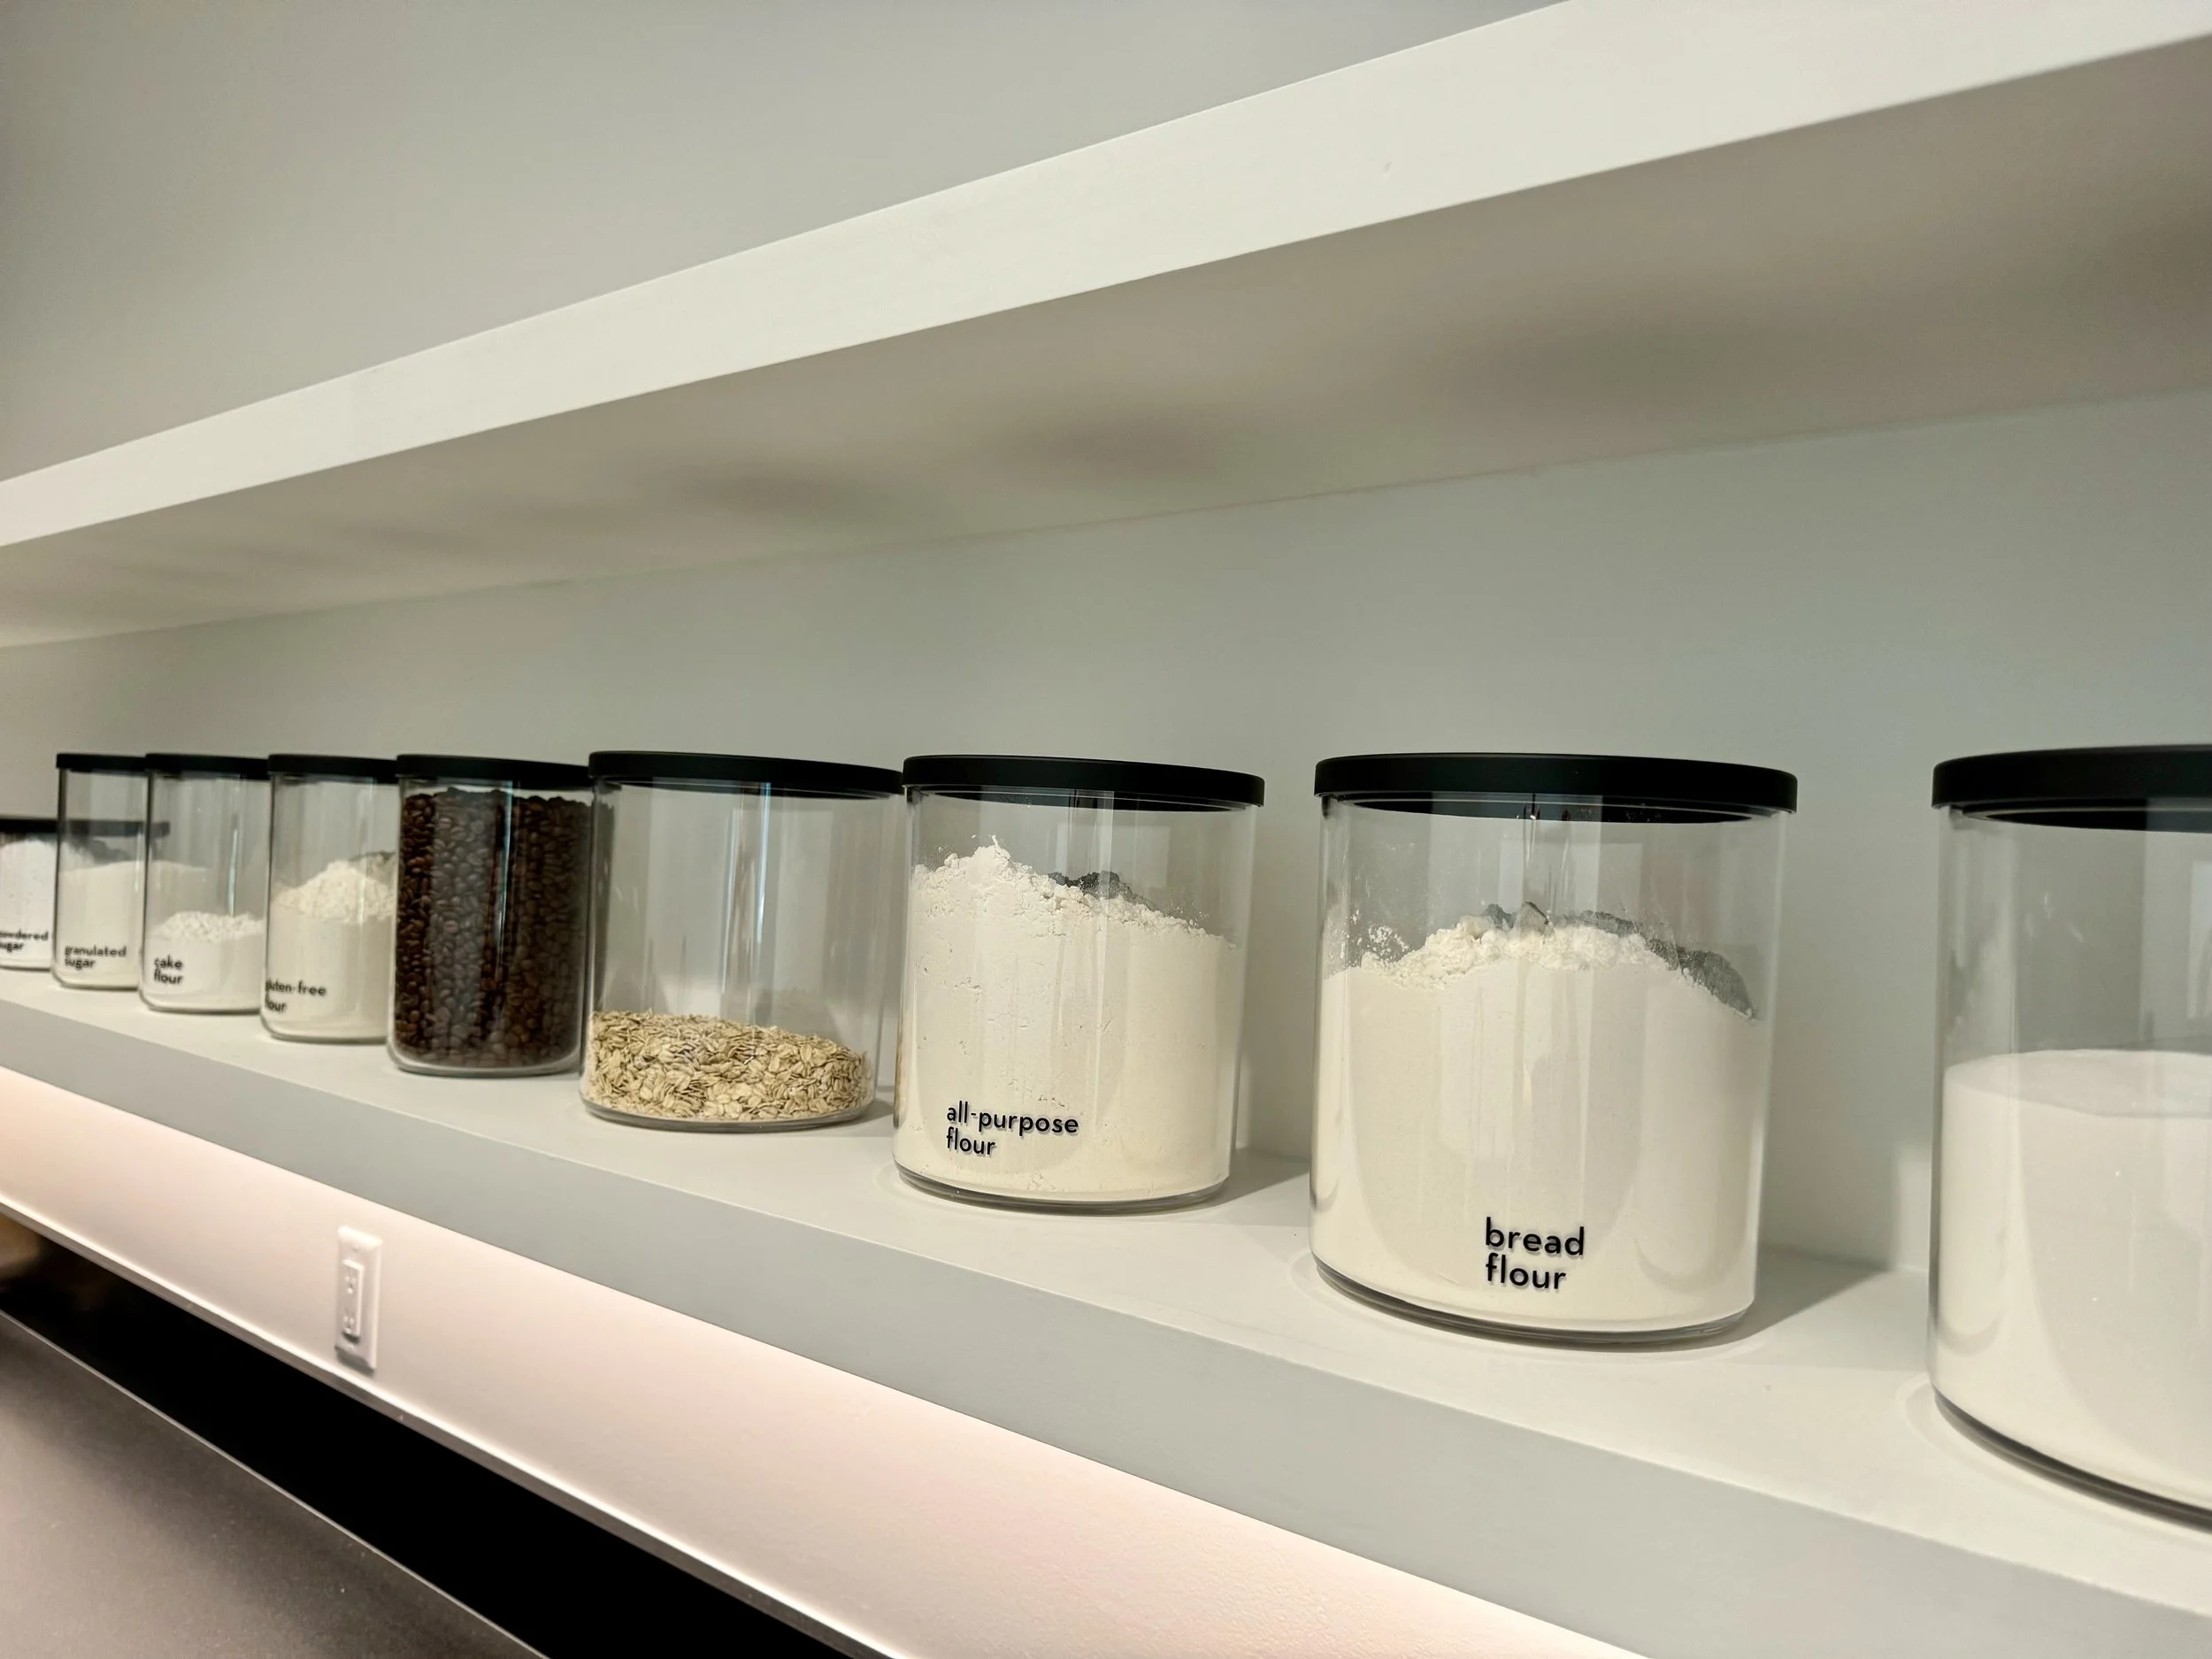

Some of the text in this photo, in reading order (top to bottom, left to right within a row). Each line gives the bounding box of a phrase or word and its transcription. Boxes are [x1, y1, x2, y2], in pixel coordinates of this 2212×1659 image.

[0, 929, 49, 941] owdered
[0, 942, 24, 953] ugar
[65, 944, 127, 958] granulated
[65, 958, 95, 971] sugar
[154, 955, 183, 970] cake
[154, 969, 183, 984] flour
[946, 1100, 1079, 1137] all-purpose
[946, 1126, 996, 1156] flour
[1486, 1216, 1585, 1256] bread
[1486, 1252, 1567, 1290] flour
